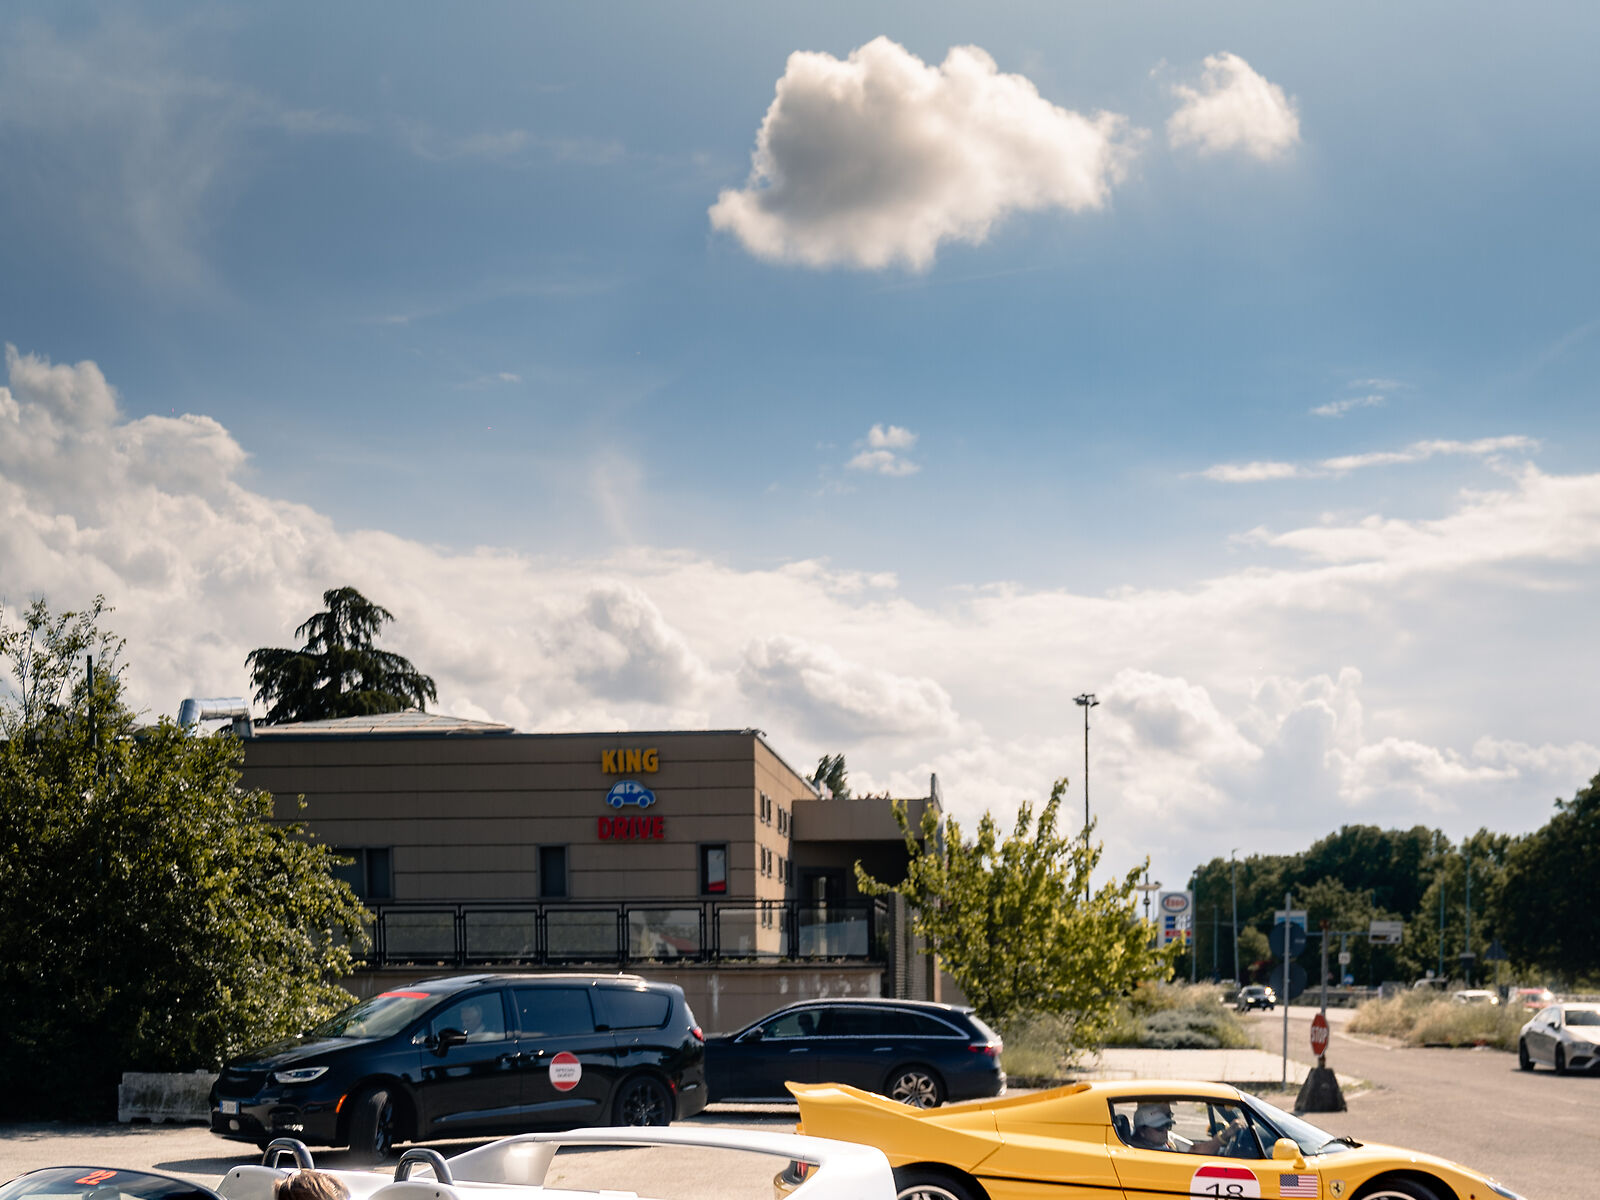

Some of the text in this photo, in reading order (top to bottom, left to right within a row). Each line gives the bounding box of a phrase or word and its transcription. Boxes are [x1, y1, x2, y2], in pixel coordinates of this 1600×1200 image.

[601, 748, 659, 773] KING
[597, 816, 665, 840] DRIVE
[1311, 1026, 1328, 1043] STOP
[74, 1170, 118, 1185] 22
